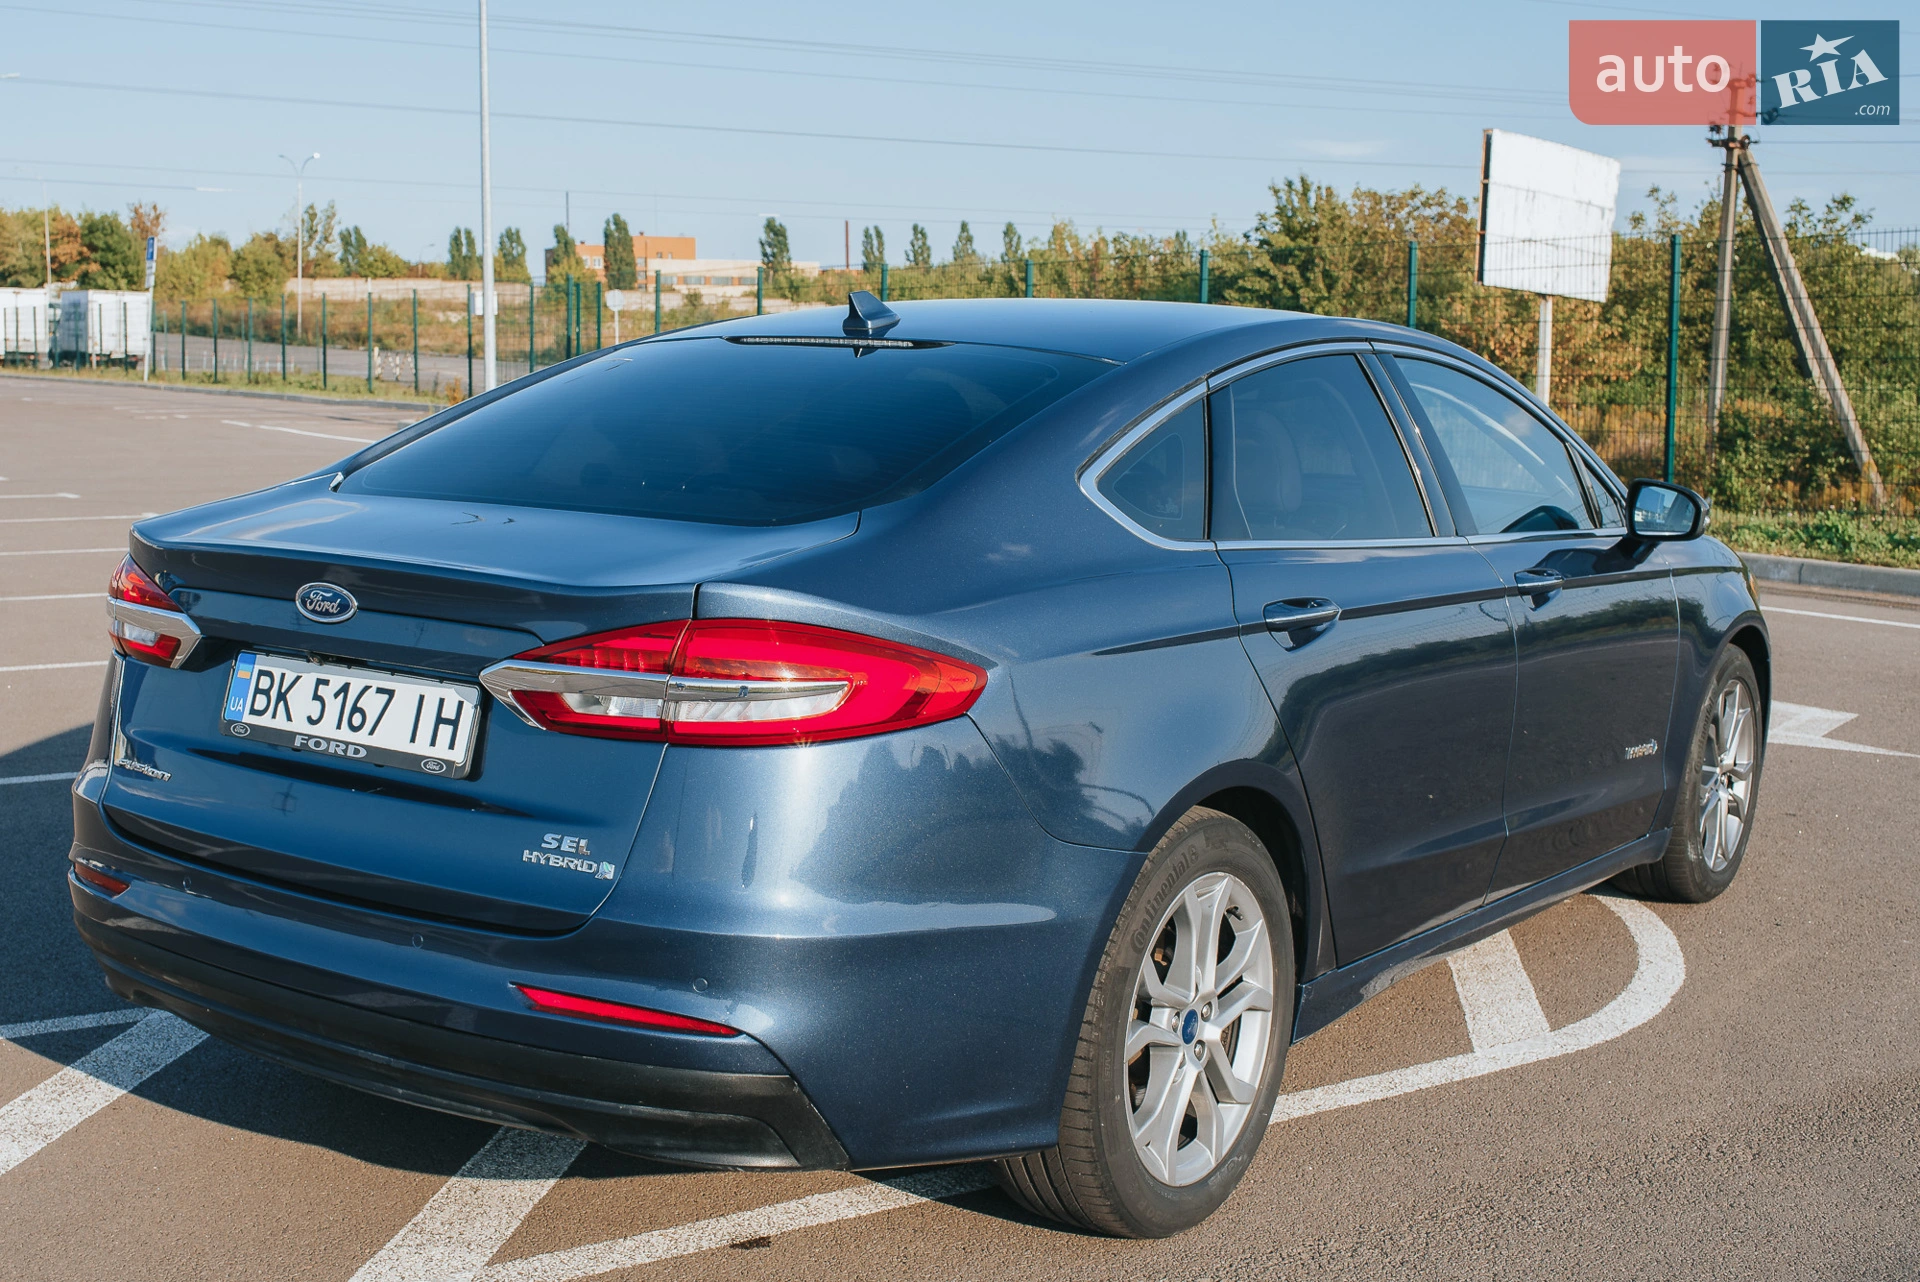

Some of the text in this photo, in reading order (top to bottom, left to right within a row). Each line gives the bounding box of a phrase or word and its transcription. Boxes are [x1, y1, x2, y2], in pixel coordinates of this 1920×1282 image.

[305, 590, 341, 614] Ford
[230, 696, 244, 713] UA
[248, 669, 465, 751] BK 5167 IH
[293, 734, 368, 759] FORD
[540, 833, 592, 856] SEL
[522, 849, 598, 874] HYBRID
[1131, 852, 1191, 954] Continental
